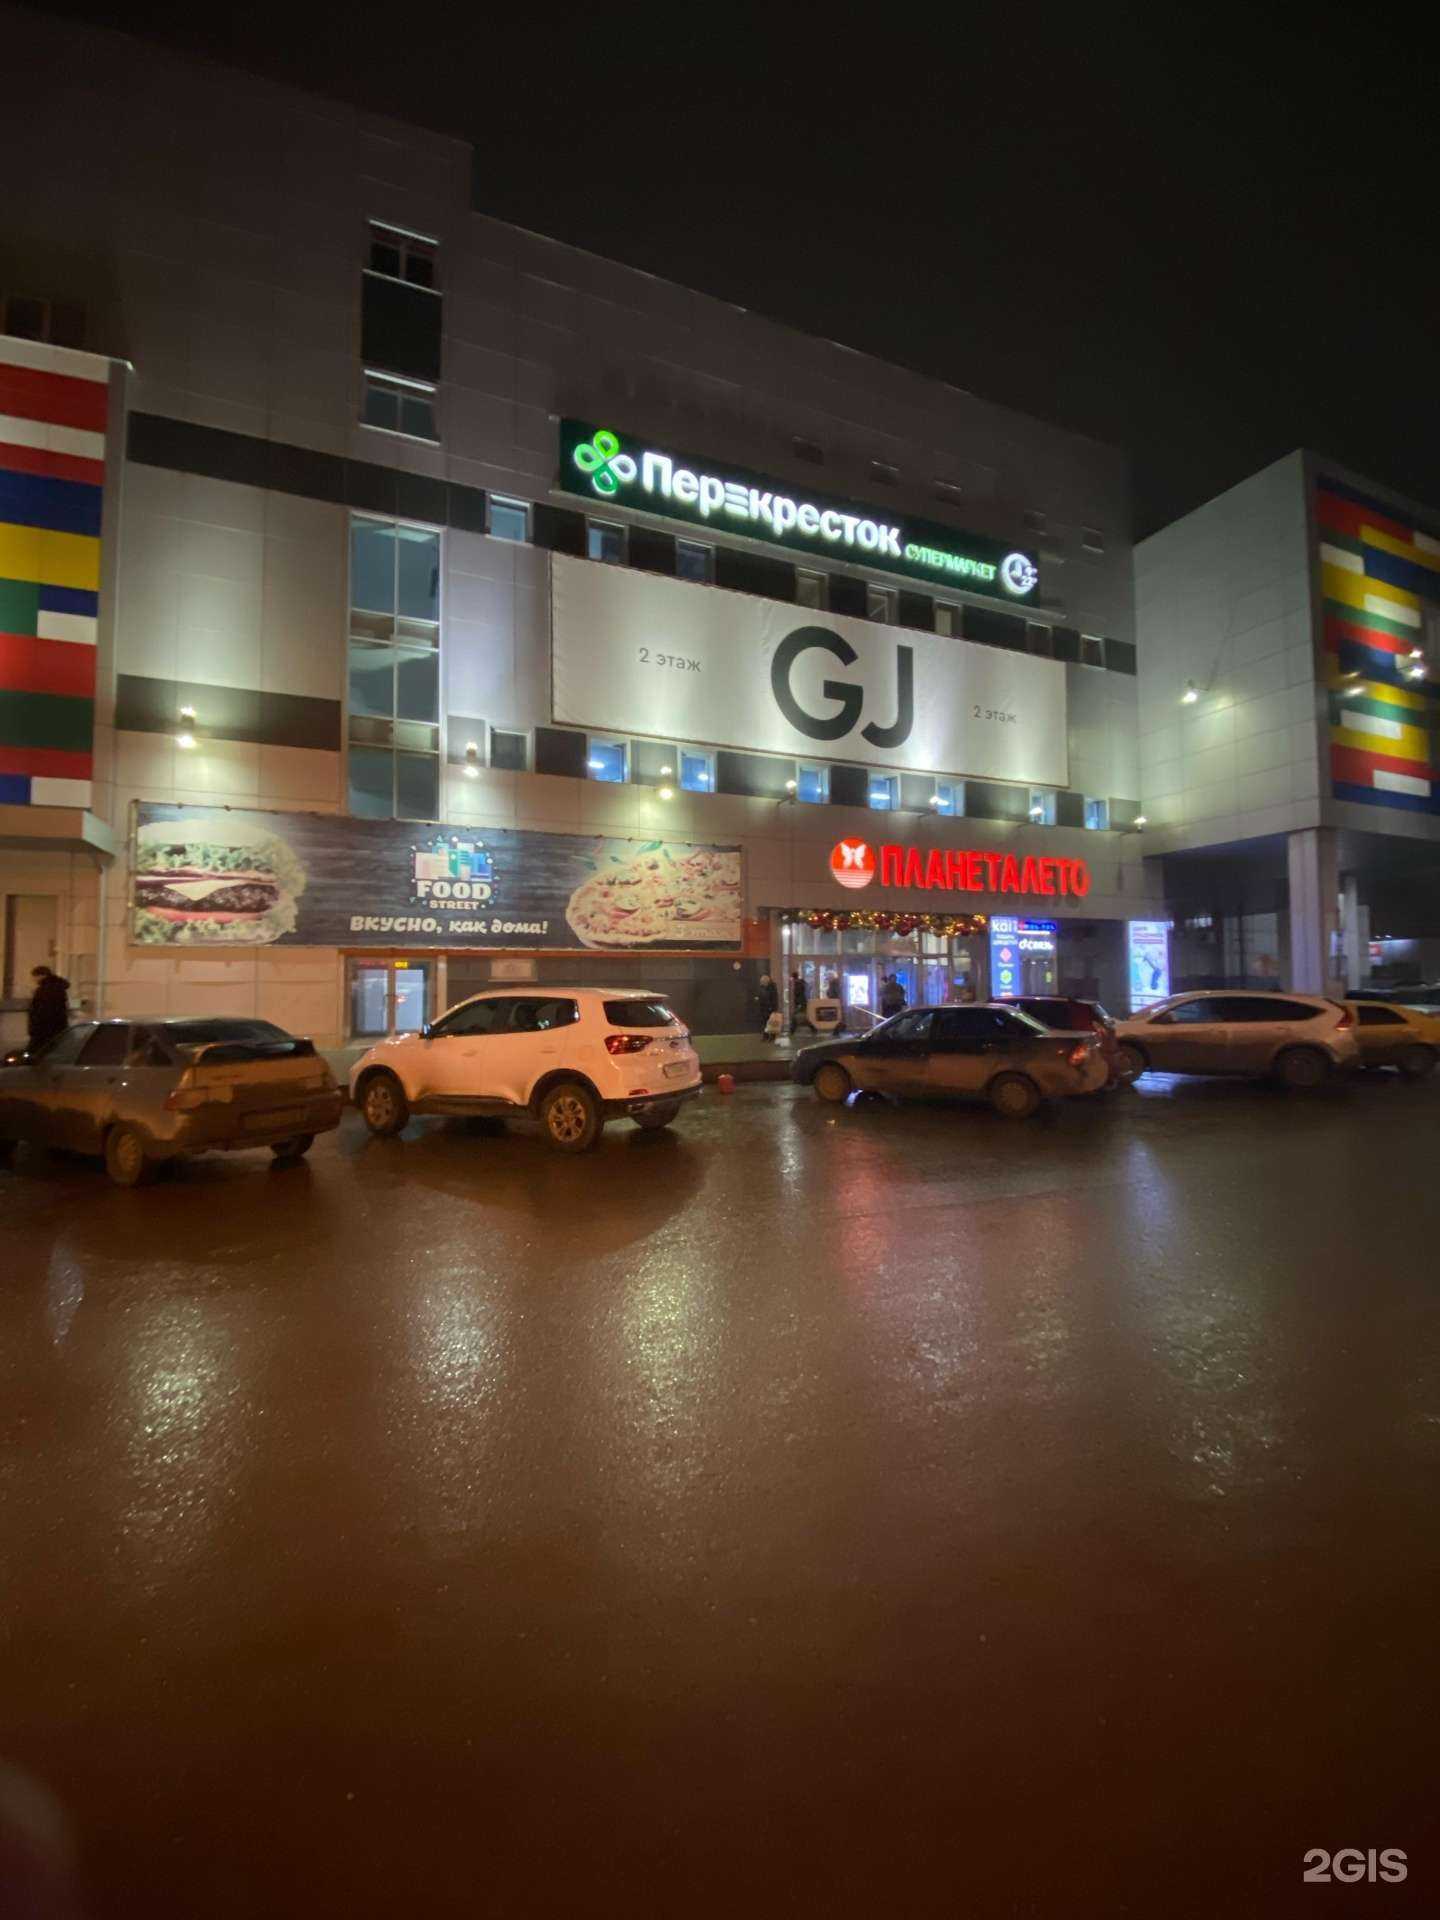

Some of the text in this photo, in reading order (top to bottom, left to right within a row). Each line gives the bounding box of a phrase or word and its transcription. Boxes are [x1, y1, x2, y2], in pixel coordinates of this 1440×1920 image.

[642, 452, 998, 581] Перекресток СУПЕРМАРКЕТ
[638, 647, 702, 673] 2 этаж
[771, 625, 915, 749] GJ
[973, 704, 1017, 724] 2 этаж
[880, 845, 1090, 896] ПЛАНЕТАЛЕТО
[415, 880, 492, 899] FOOD
[429, 900, 480, 910] STREET
[350, 916, 550, 935] ВКУСНО, как дома!
